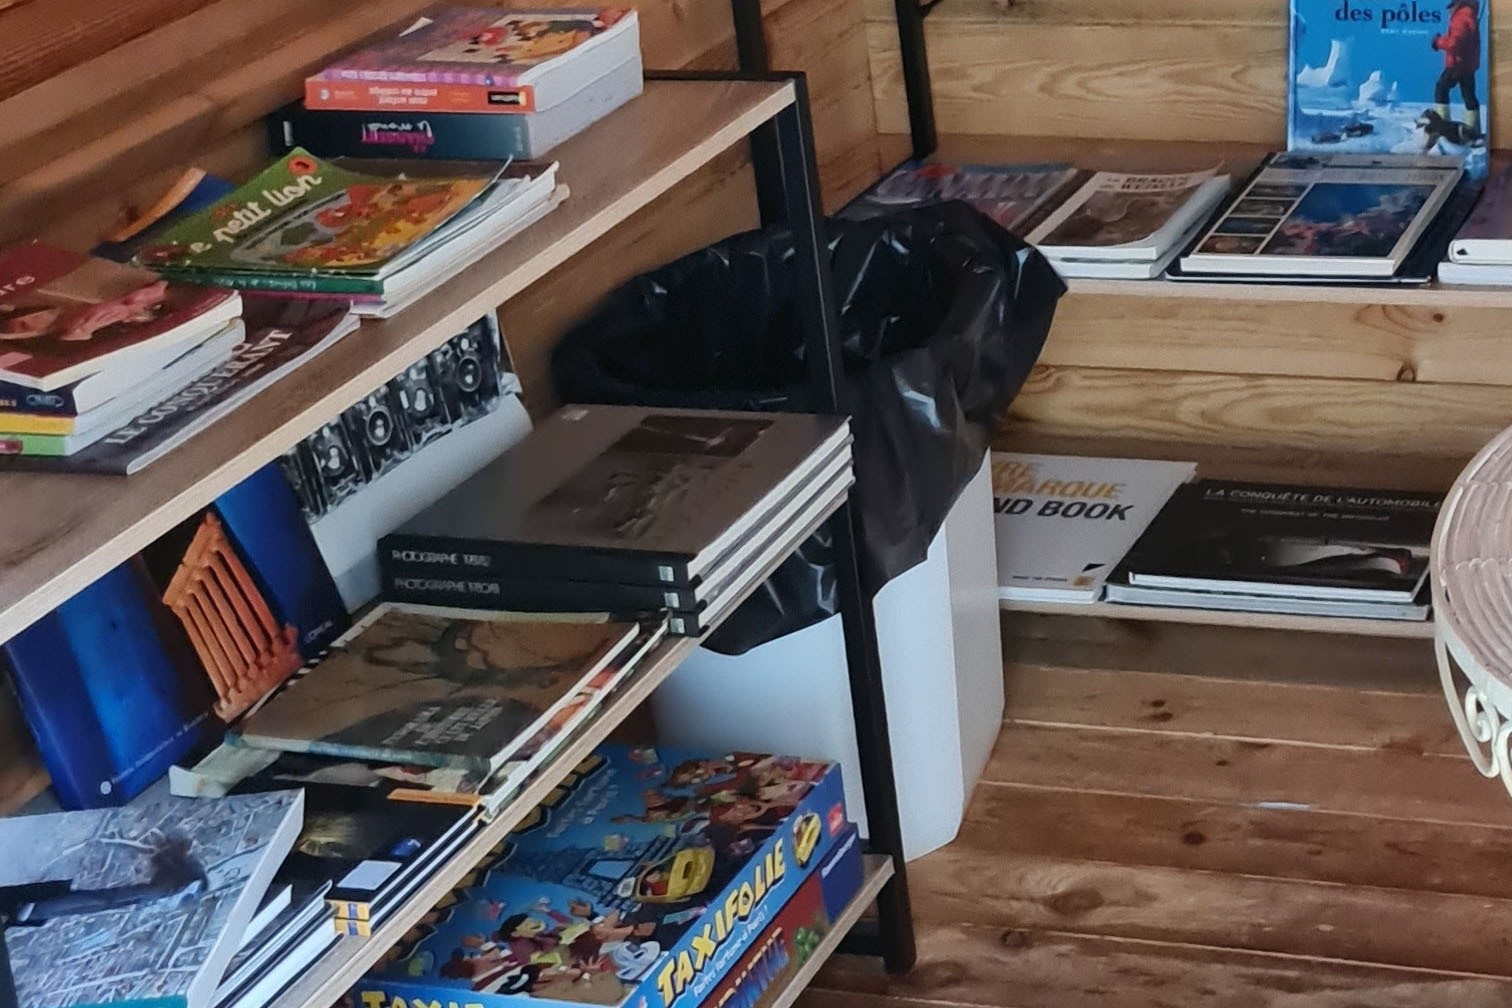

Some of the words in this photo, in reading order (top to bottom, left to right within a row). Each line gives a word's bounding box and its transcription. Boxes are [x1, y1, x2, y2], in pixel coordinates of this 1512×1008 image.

[1335, 1, 1373, 23] des
[1381, 1, 1442, 29] pôles
[212, 200, 272, 243] petit
[263, 170, 324, 210] lion
[1205, 486, 1226, 500] LA
[1229, 486, 1310, 504] CONQUÊTE
[1313, 492, 1335, 505] DE
[1037, 500, 1134, 521] BOOK
[655, 838, 788, 1006] TAXIFOLIE
